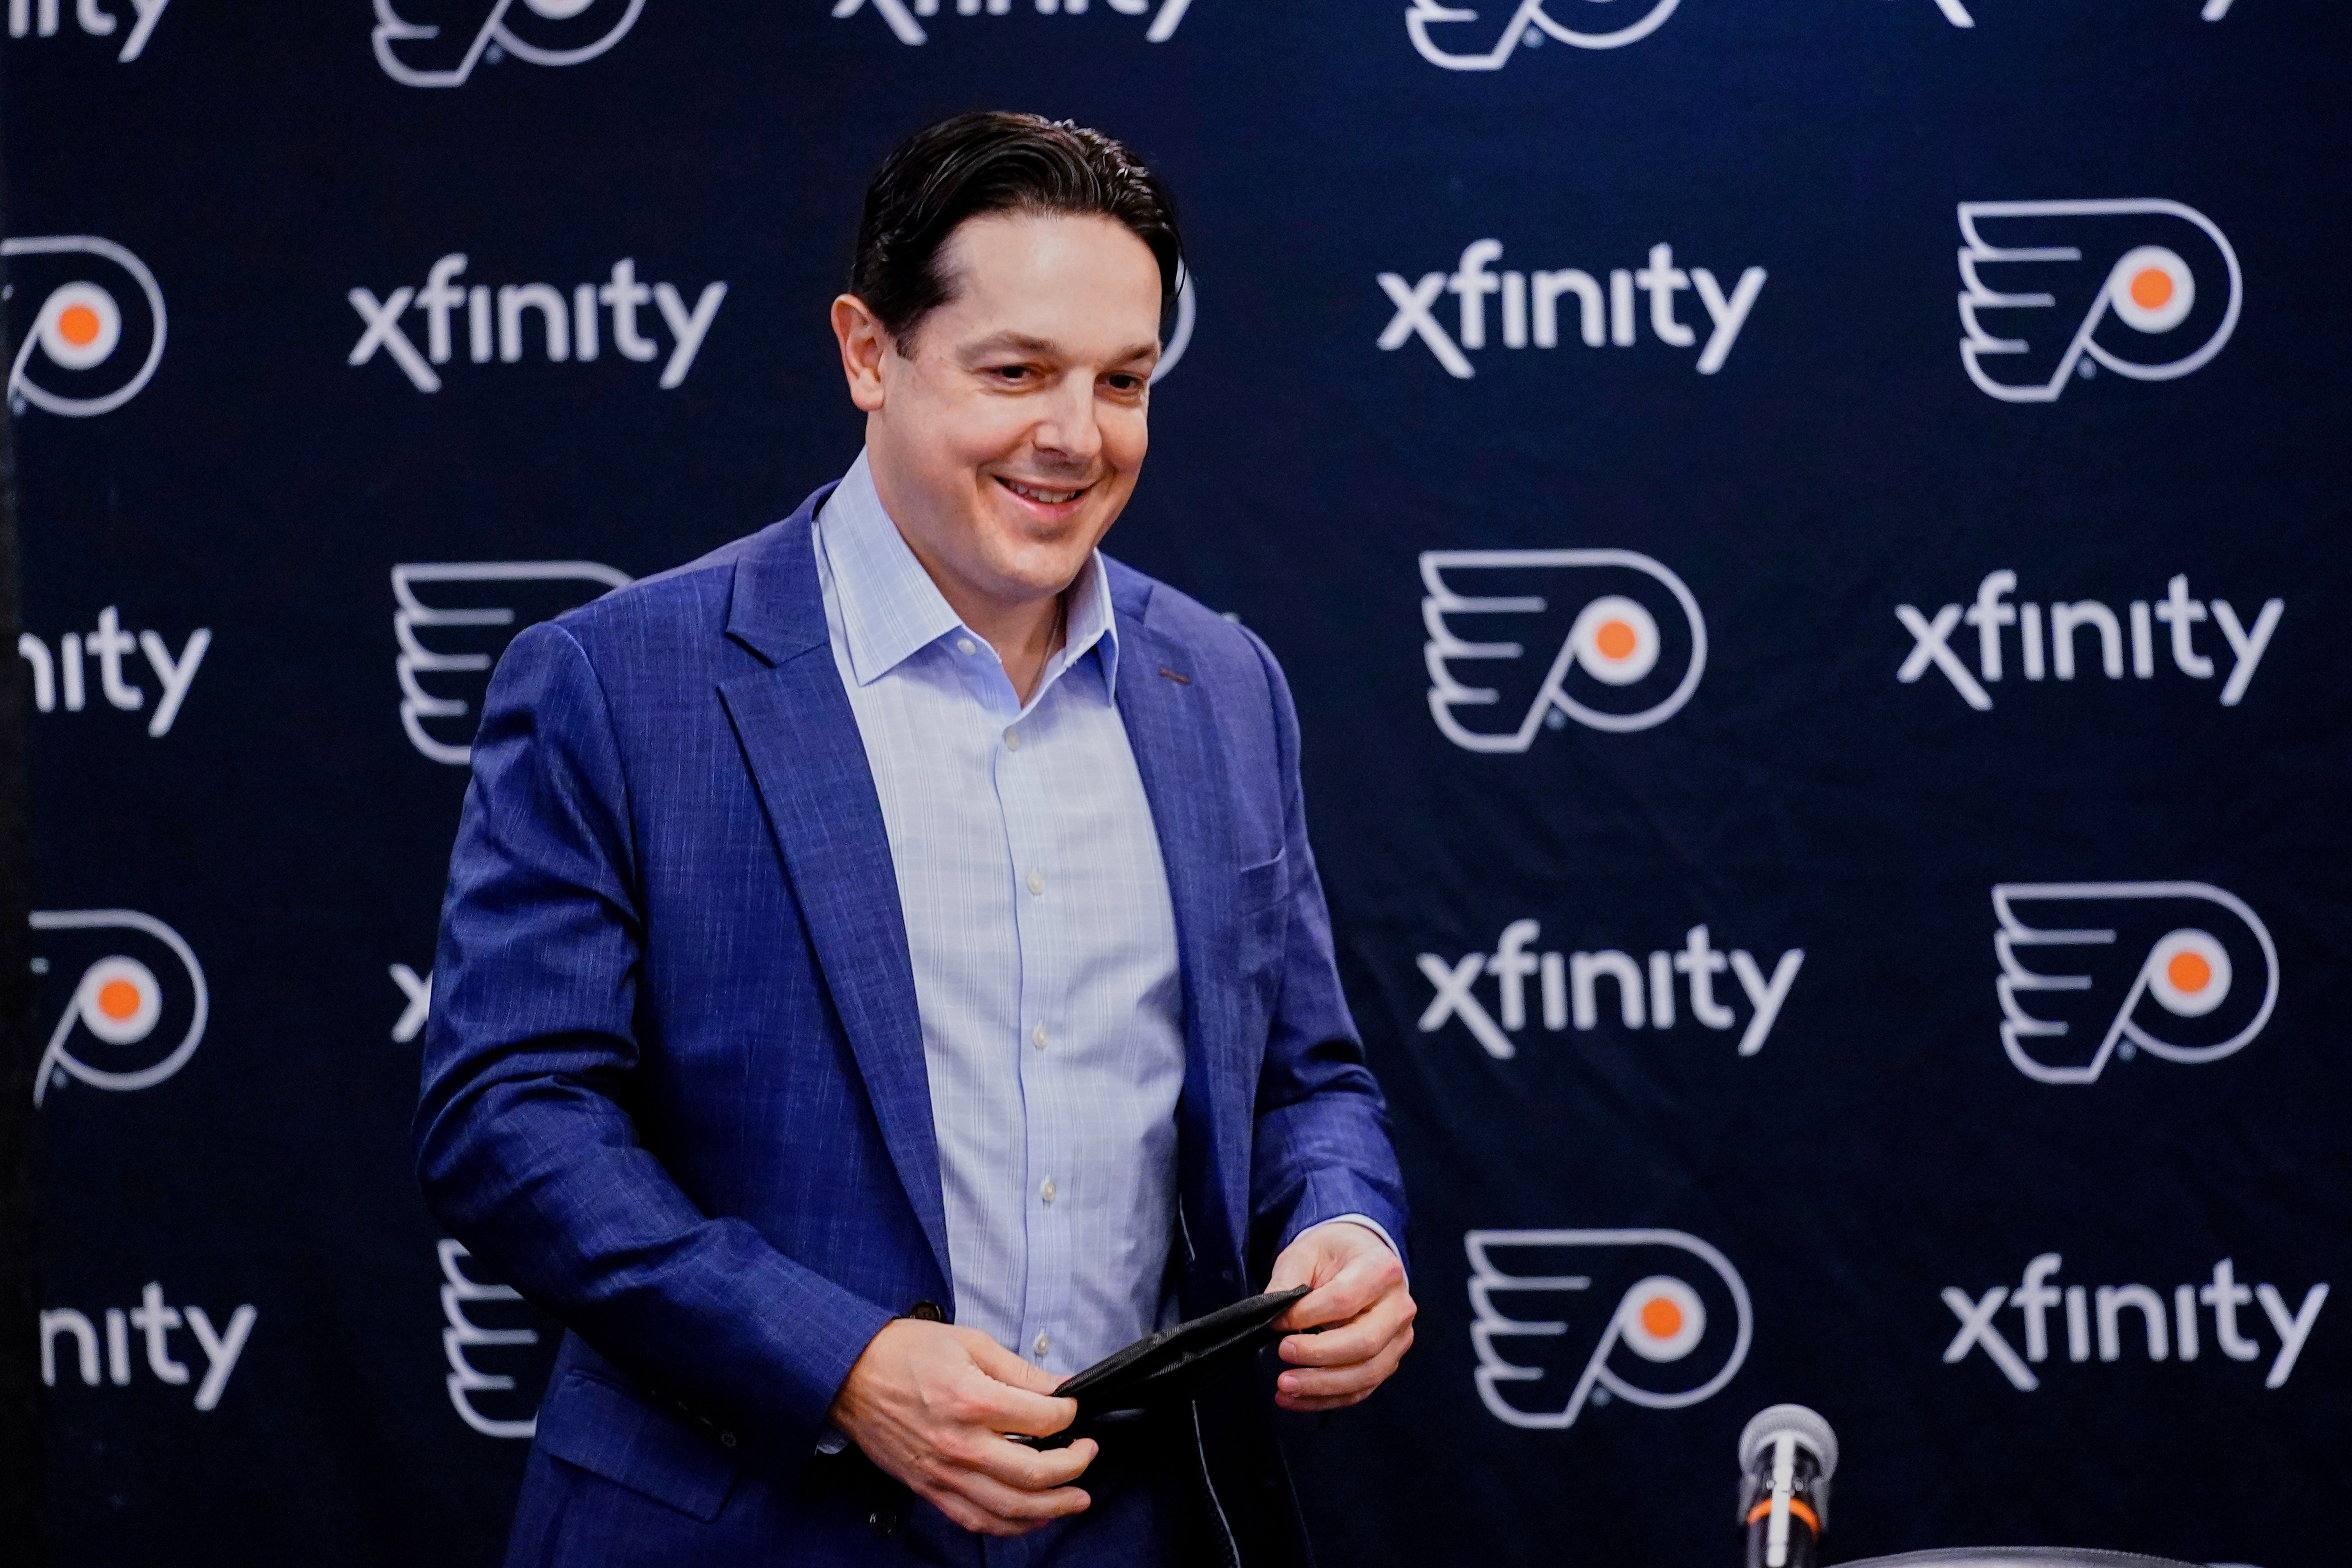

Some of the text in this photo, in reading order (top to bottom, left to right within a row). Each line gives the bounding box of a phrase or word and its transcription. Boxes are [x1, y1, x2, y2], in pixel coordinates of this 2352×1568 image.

[349, 254, 727, 392] xfinity
[1377, 238, 1767, 379] xfinity
[1895, 570, 2284, 710] xfinity
[1417, 919, 1804, 1058] xfinity
[1942, 1253, 2329, 1390] xfinity
